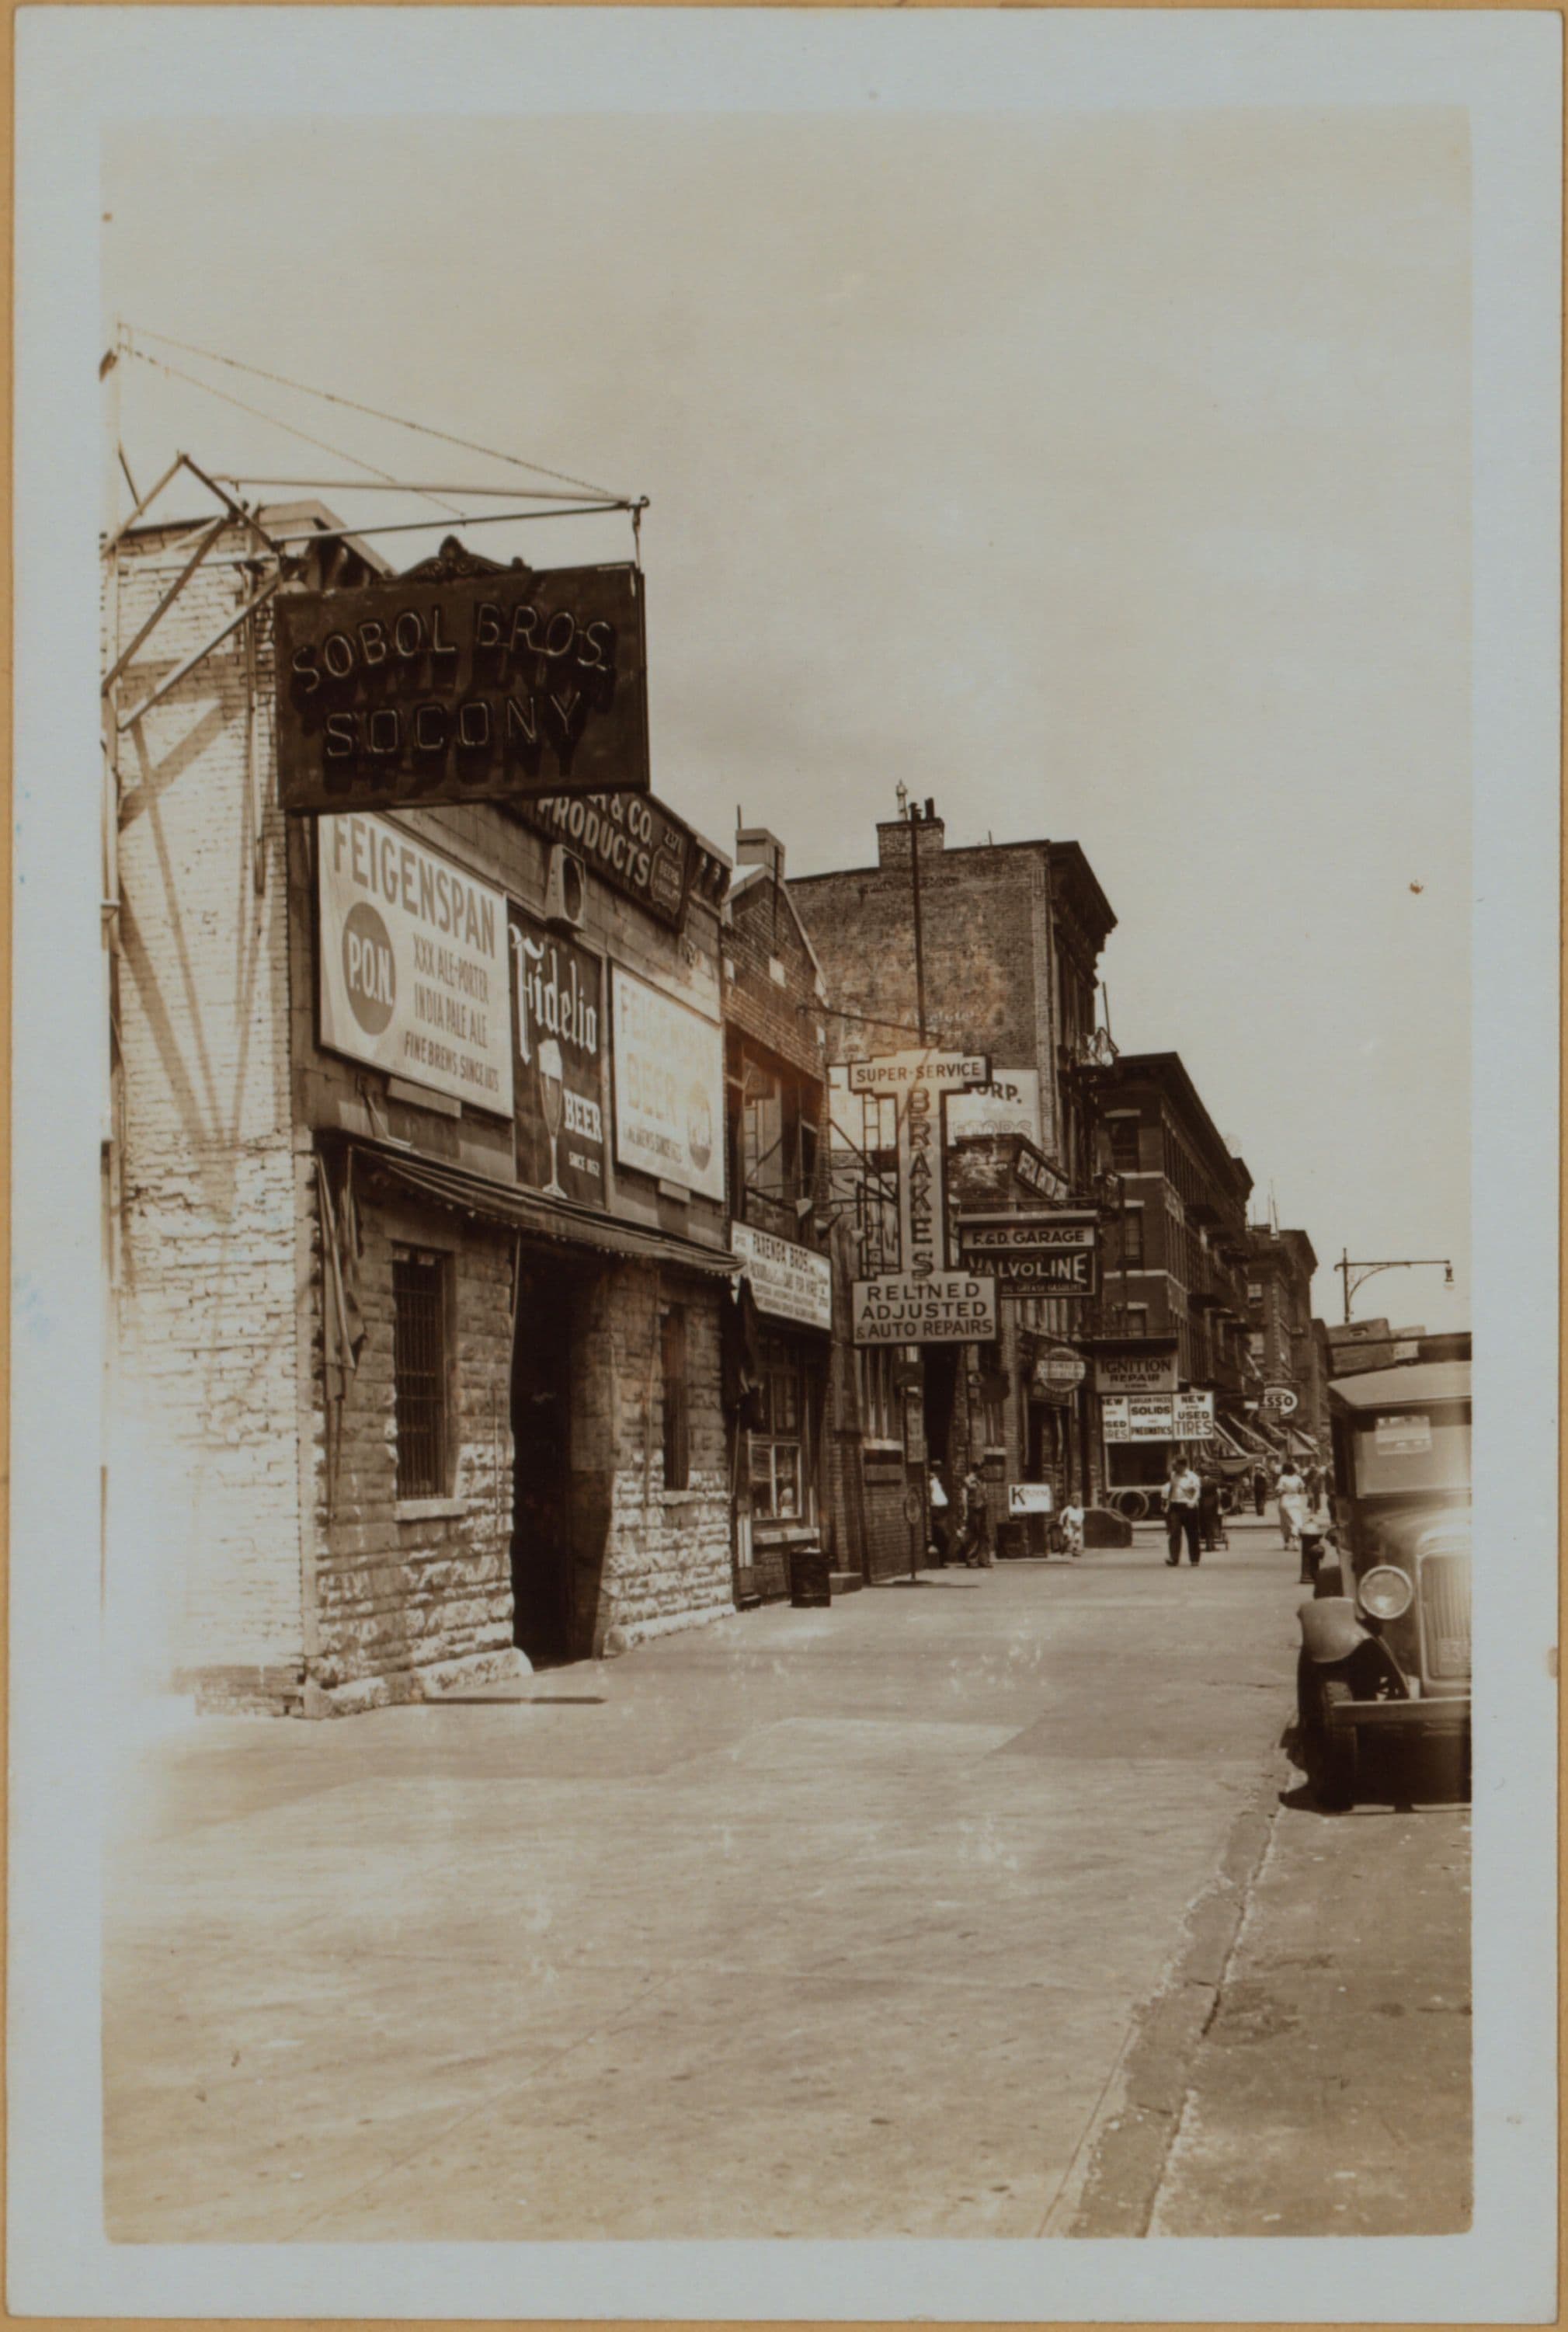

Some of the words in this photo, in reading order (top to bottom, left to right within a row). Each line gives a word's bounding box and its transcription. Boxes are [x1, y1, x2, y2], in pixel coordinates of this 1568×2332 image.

[292, 609, 456, 692] SOBOL
[476, 604, 612, 672] BROS
[326, 691, 581, 757] SOCONY
[332, 815, 495, 959] FEIGENSPAN
[412, 933, 435, 977] XXX
[348, 929, 393, 1008] P.O.N.
[414, 982, 445, 1030] INDIA
[446, 997, 467, 1039] PALE
[469, 1009, 488, 1049] ALE
[404, 1031, 427, 1063] FINE
[428, 1040, 458, 1076] BREWS
[459, 1054, 484, 1087] SINCE
[970, 1082, 1023, 1104] ORP.
[563, 1088, 603, 1144] BEER
[908, 1089, 935, 1280] BRAKES
[1012, 1230, 1085, 1244] GARAGE
[968, 1252, 1088, 1285] VALVOLINE
[867, 1283, 980, 1301] RELINED
[862, 1302, 986, 1321] ADJUSTED
[857, 1325, 865, 1340] &
[868, 1322, 916, 1338] AUTO
[923, 1318, 993, 1336] REPAIRS
[1100, 1359, 1171, 1373] IGNITION
[1110, 1373, 1160, 1382] REPAIR
[1131, 1406, 1171, 1415] SOLIDS
[1181, 1395, 1205, 1404] NEW
[1178, 1411, 1209, 1419] USED
[1104, 1429, 1128, 1439] IRES
[1174, 1420, 1212, 1436] TIRES
